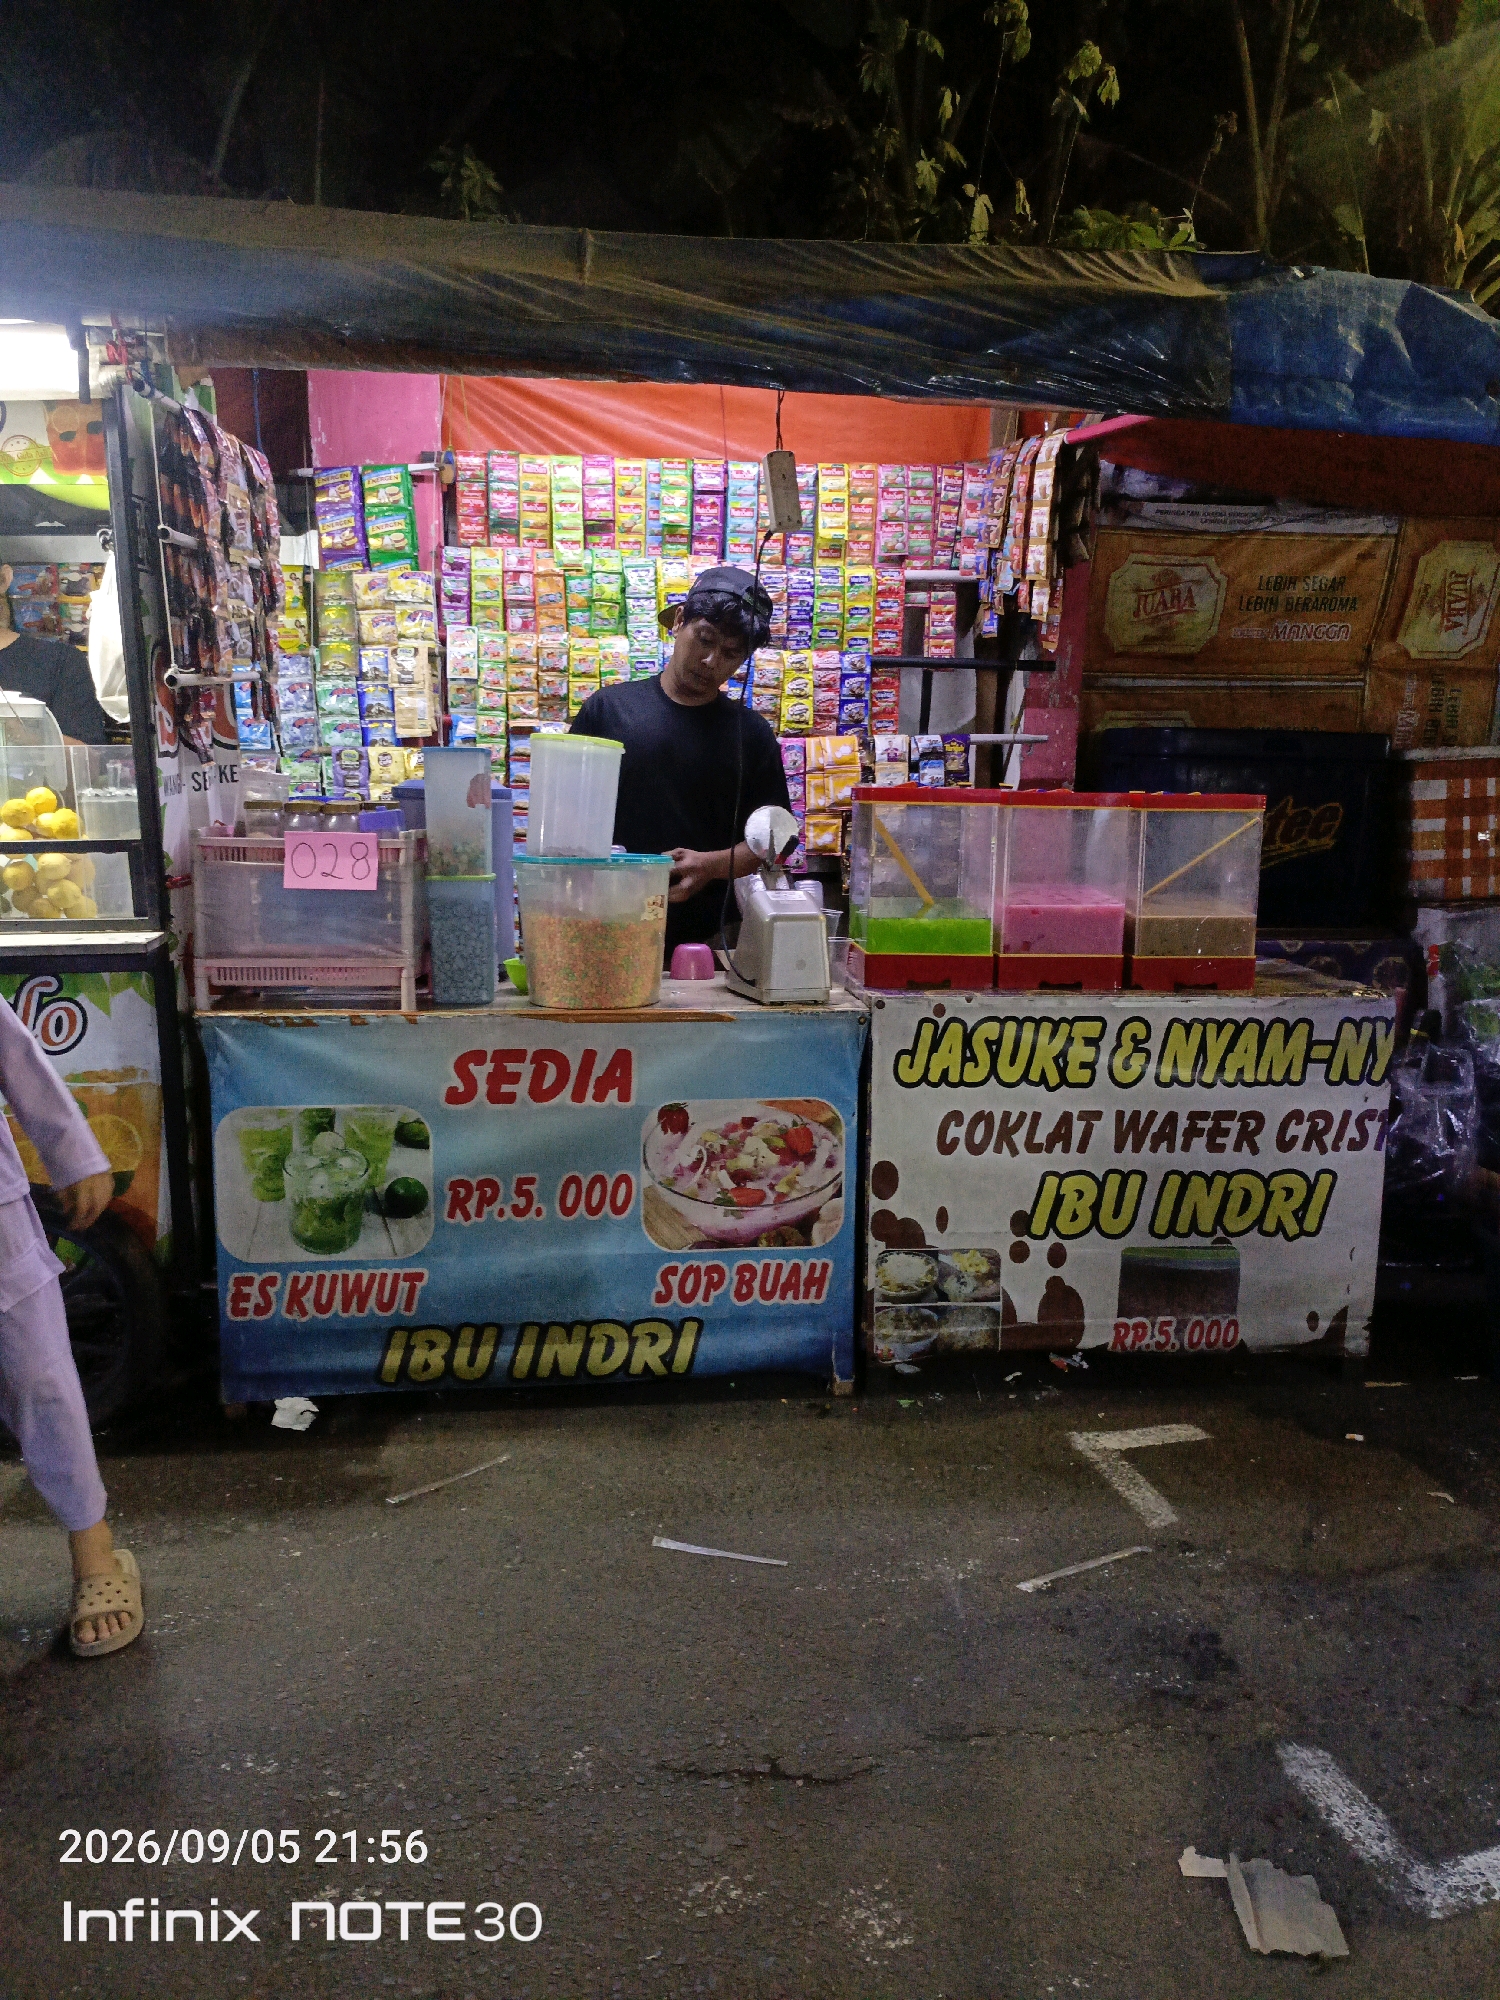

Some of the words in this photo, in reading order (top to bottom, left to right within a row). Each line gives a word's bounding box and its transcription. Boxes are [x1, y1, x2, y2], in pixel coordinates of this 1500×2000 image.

[317, 472, 350, 484] ENERGEN
[367, 474, 399, 485] ENERGEN
[321, 518, 353, 531] ENERGEN
[371, 521, 404, 532] ENERGEN
[1132, 585, 1197, 619] JUARA
[1238, 596, 1280, 613] LEBIH
[1285, 597, 1359, 613] BERAROMA
[1257, 576, 1298, 592] LEBIH
[1302, 576, 1347, 593] SEGAR
[1443, 569, 1469, 633] JUARA
[1268, 620, 1352, 642] MANGGA
[290, 841, 373, 881] 028
[894, 1013, 1107, 1091] JASUKE
[1108, 1014, 1152, 1087] &
[444, 1047, 635, 1106] SEDIA
[936, 1108, 1103, 1158] COKLAT
[1113, 1108, 1267, 1157] WAFER
[558, 1171, 635, 1219] 000
[1028, 1168, 1148, 1240] IBU
[1149, 1168, 1337, 1241] INDRI
[228, 1272, 274, 1318] ES
[285, 1269, 427, 1318] KUWUT
[653, 1261, 724, 1306] SOP
[732, 1260, 832, 1304] BUAH
[378, 1322, 504, 1386] IBU
[509, 1317, 702, 1382] INDRI
[1185, 1317, 1241, 1349] 000
